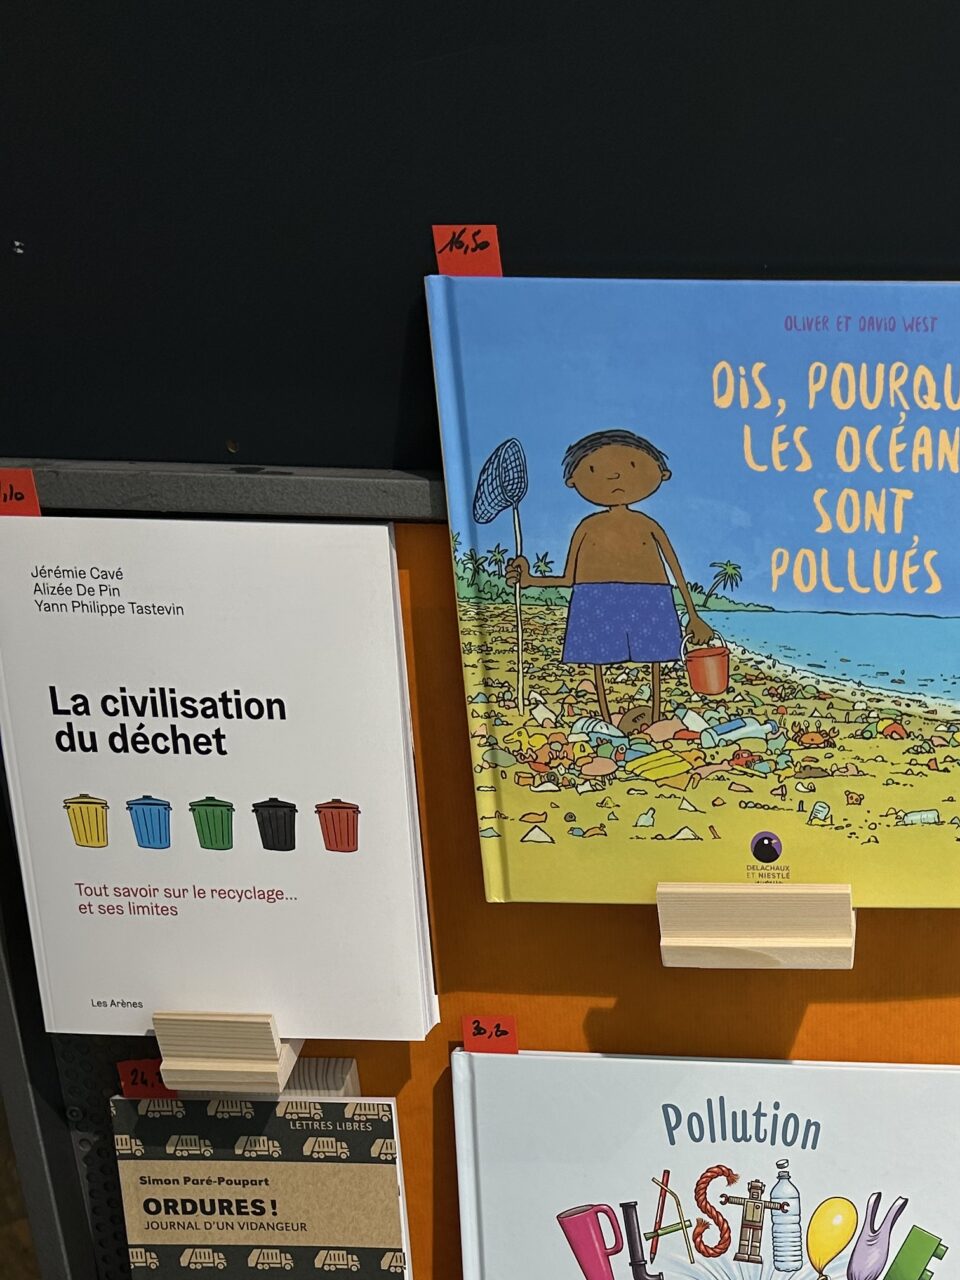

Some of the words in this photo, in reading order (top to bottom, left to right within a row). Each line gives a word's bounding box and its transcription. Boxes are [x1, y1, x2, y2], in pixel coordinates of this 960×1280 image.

[836, 315, 852, 332] ET
[902, 315, 938, 333] WEST
[743, 424, 812, 472] LES
[813, 487, 914, 534] SONT
[771, 534, 942, 594] POLLUÉS
[31, 565, 86, 580] Jérémie
[90, 567, 123, 580] Cavé
[33, 583, 72, 596] Alizée
[77, 584, 95, 596] De
[99, 584, 120, 597] Pin
[35, 600, 68, 613] Yann
[72, 601, 125, 616] Philippe
[128, 602, 184, 616] Tastevin
[48, 686, 91, 716] La
[101, 686, 287, 720] civilisation
[55, 722, 98, 752] du
[109, 723, 228, 756] déchet
[746, 864, 790, 872] DELACHAUX
[758, 871, 790, 880] NIESTLÉ
[74, 883, 108, 898] Tout
[113, 883, 160, 899] savoir
[163, 887, 189, 900] sur
[193, 885, 206, 900] le
[78, 902, 94, 915] et
[98, 903, 124, 916] ses
[128, 902, 178, 917] limites
[91, 999, 108, 1009] Les
[110, 998, 143, 1010] Arènes
[289, 1121, 333, 1131] LETTRES
[336, 1121, 372, 1132] LIBRES
[661, 1096, 821, 1151] Pollution
[139, 1175, 180, 1186] Simon
[183, 1176, 270, 1188] Paré-Poupart
[144, 1220, 201, 1231] JOURNAL
[204, 1220, 234, 1231] D'UN
[239, 1221, 307, 1233] VIDANGEUR
